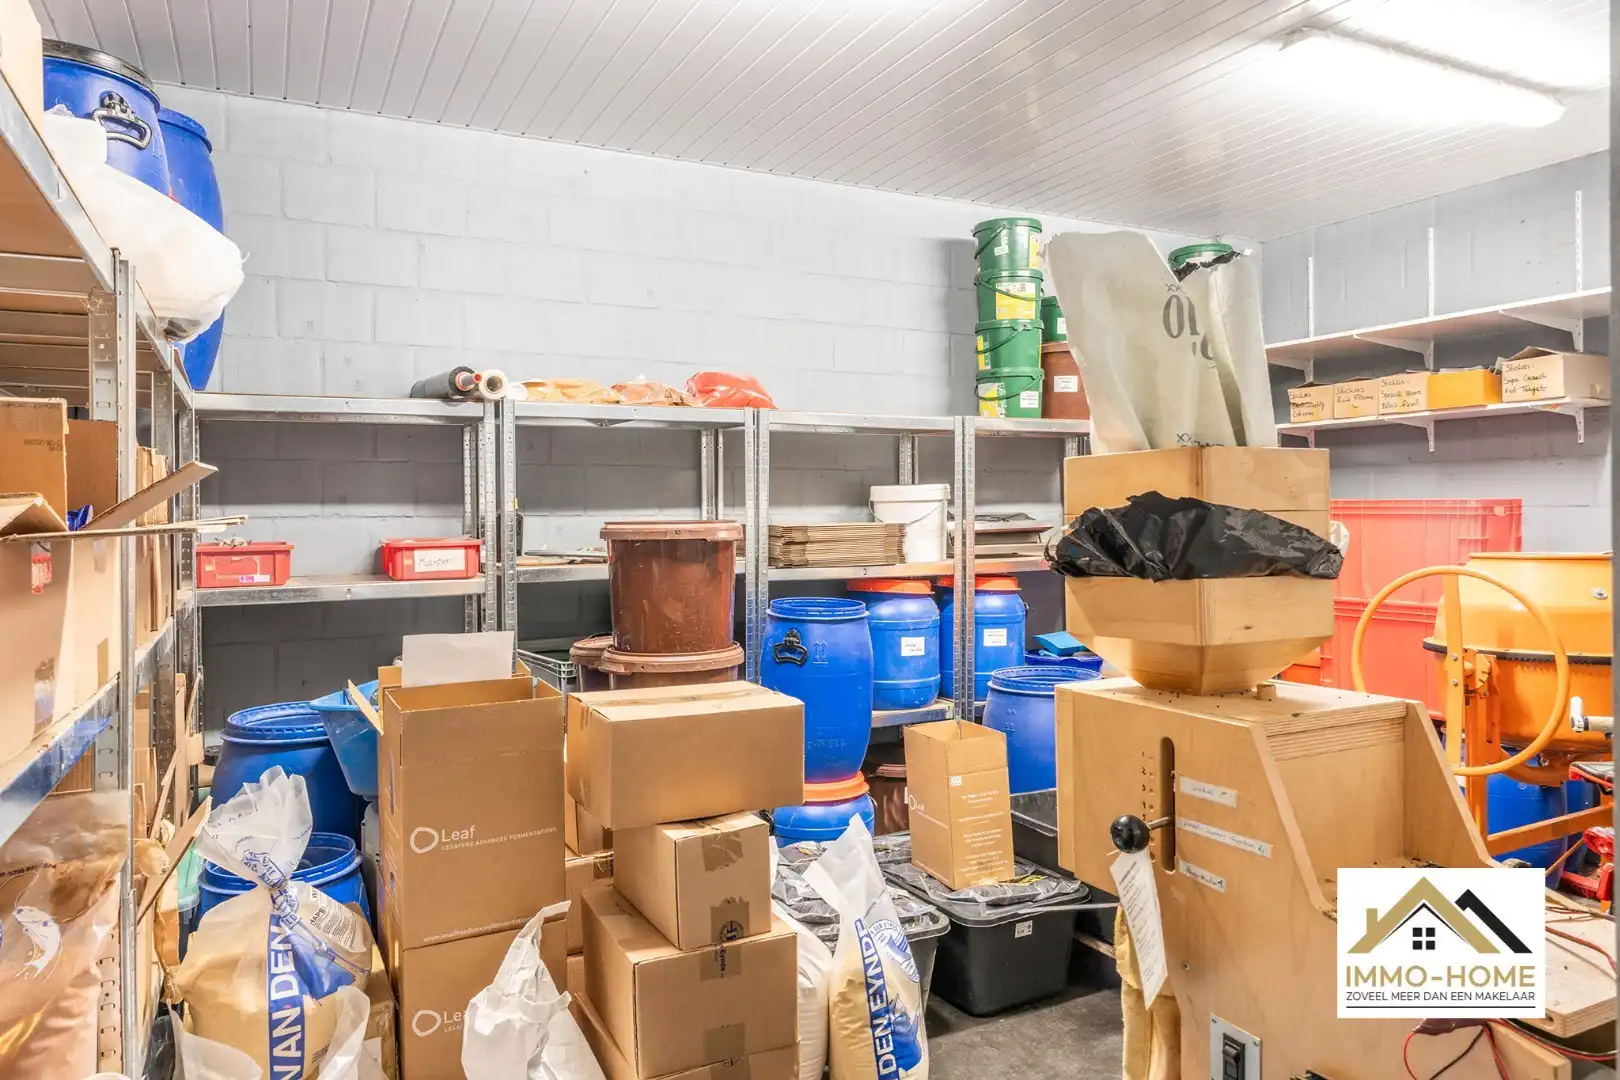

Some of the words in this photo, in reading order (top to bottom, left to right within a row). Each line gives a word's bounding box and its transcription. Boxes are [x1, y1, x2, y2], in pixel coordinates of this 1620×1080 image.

[441, 825, 476, 843] Leaf
[270, 925, 299, 1001] DEN
[444, 1010, 465, 1024] Le
[873, 1013, 897, 1076] DEN
